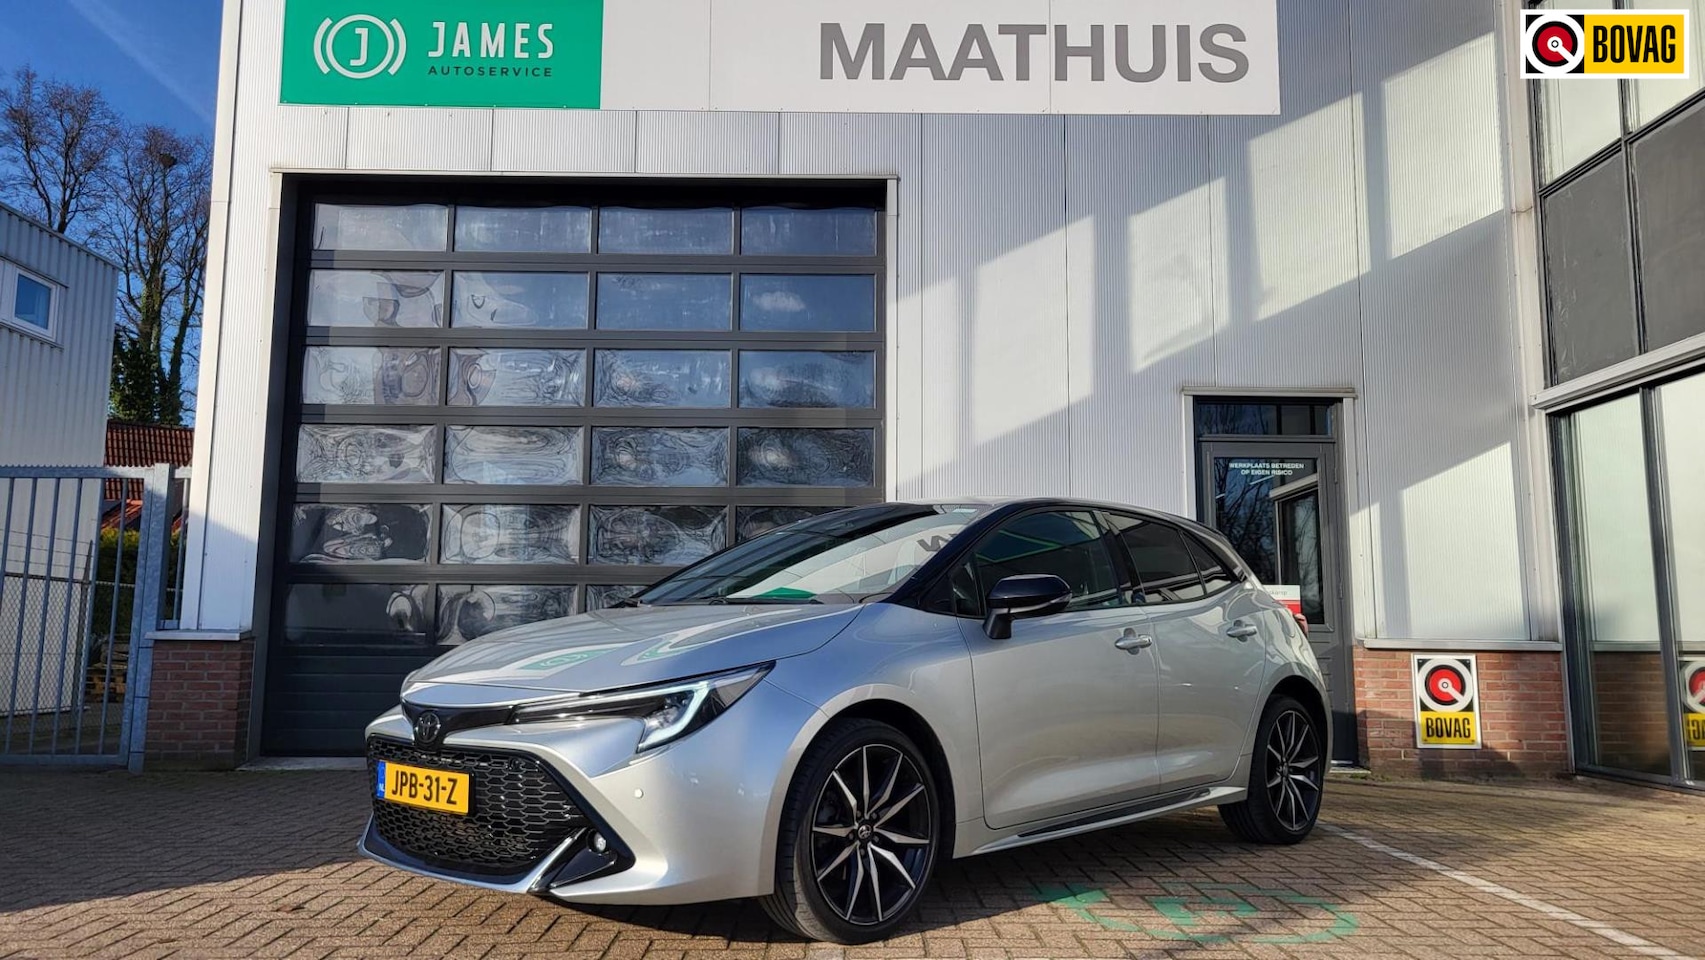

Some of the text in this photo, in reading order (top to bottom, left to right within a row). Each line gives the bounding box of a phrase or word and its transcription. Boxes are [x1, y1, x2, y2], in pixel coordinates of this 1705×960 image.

[428, 21, 554, 59] JAMES
[820, 22, 1250, 83] MAATHUIS
[428, 65, 553, 77] AUTOSERVICE
[1426, 717, 1471, 738] BOVAG
[391, 769, 458, 806] JPB-31-Z
